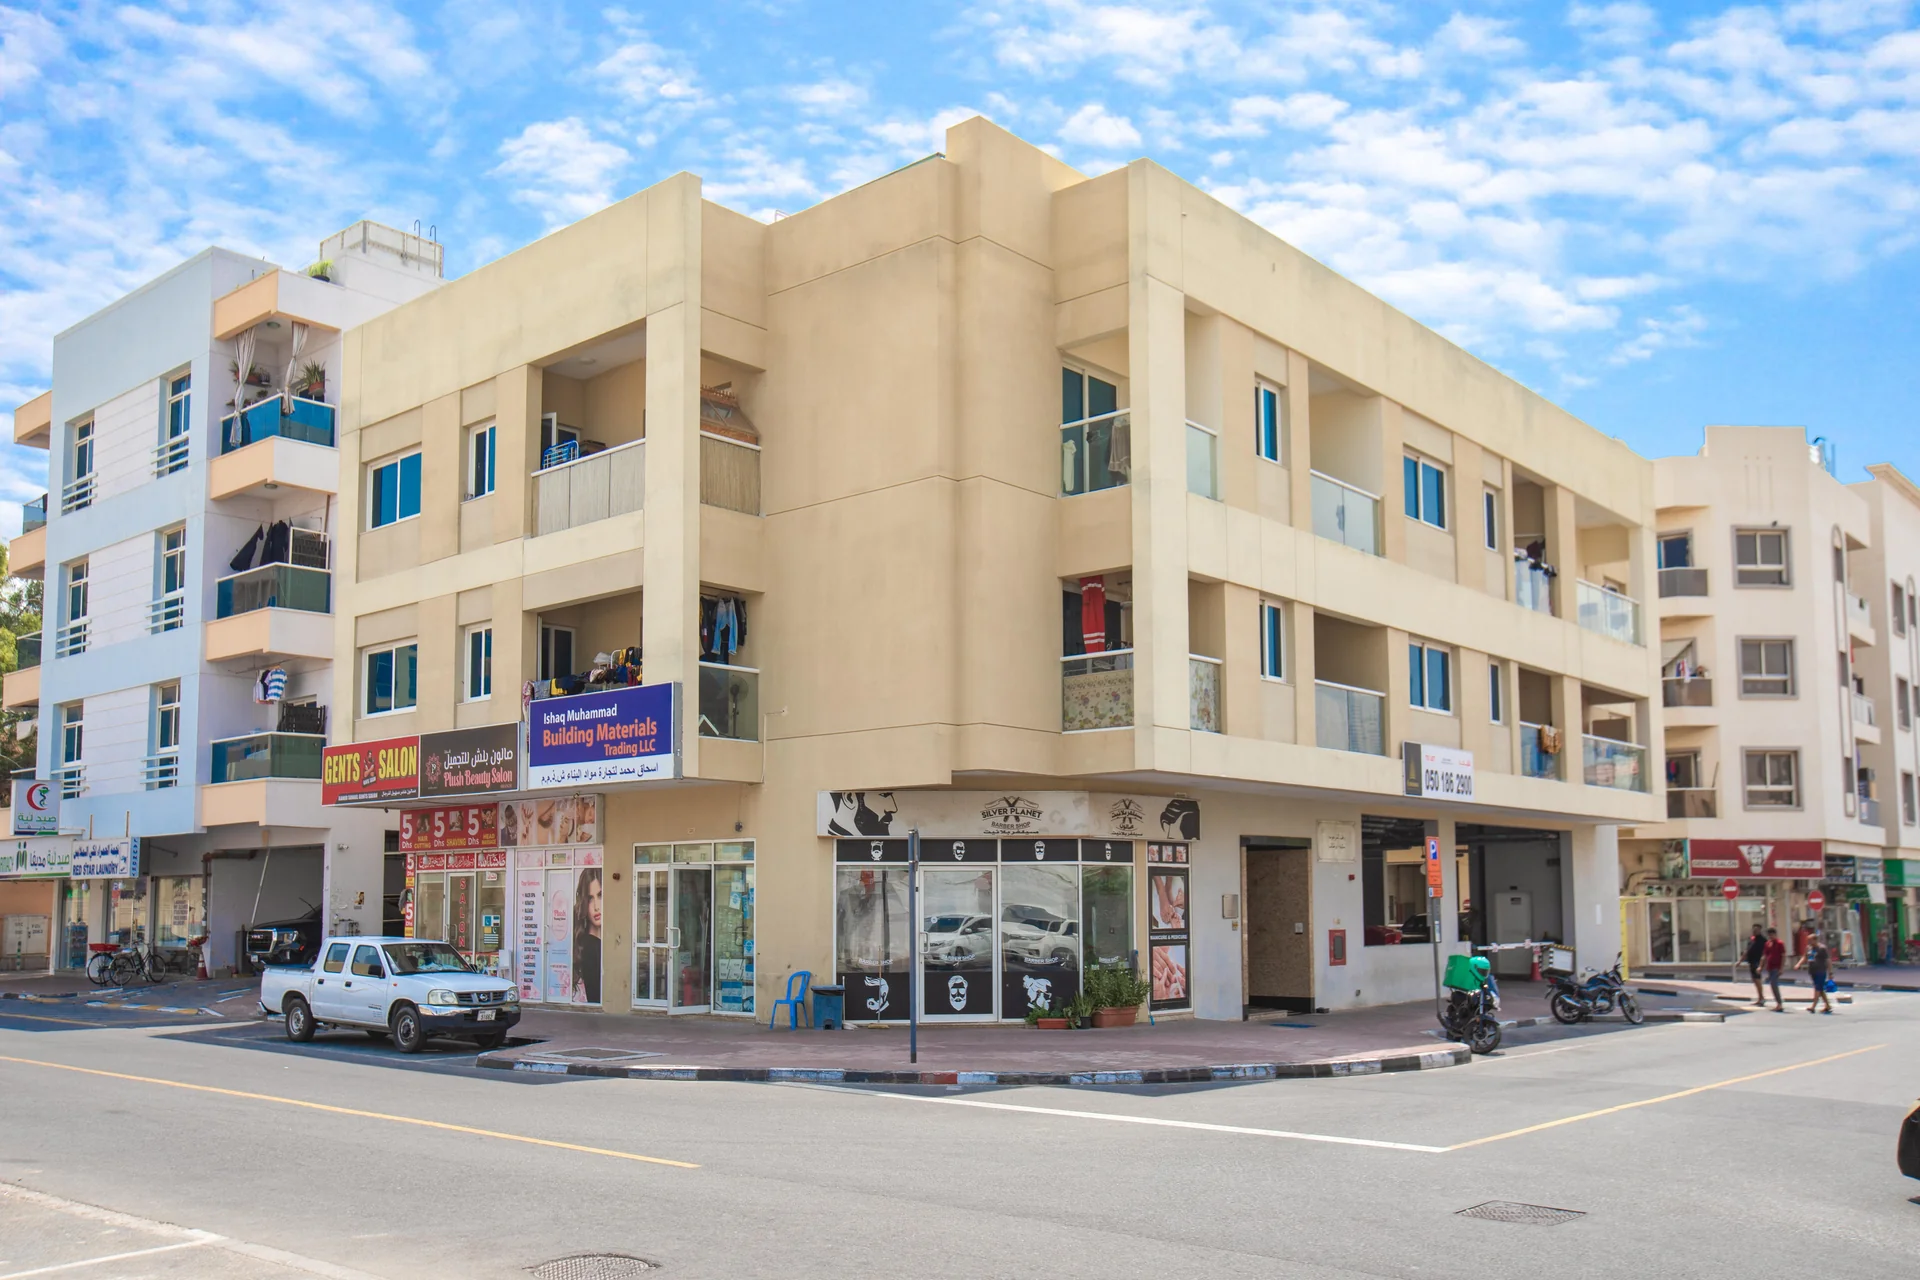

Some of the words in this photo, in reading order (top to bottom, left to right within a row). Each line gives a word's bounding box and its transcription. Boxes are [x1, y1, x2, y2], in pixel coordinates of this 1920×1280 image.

[543, 713, 566, 725] Ishaq
[566, 704, 618, 722] Muhammad
[543, 726, 594, 747] Building
[596, 717, 657, 741] Materials
[490, 747, 513, 766] صالون
[604, 743, 638, 757] Trading
[639, 739, 656, 752] LLC
[324, 752, 361, 785] GENTS
[378, 745, 417, 779] SALON
[443, 752, 470, 770] للتجميل
[470, 748, 489, 768] بلش
[443, 771, 464, 788] Plush
[464, 770, 491, 789] Beauty
[491, 766, 513, 784] Salon
[619, 767, 636, 775] محمد
[1425, 768, 1440, 791] 050
[1441, 771, 1454, 793] 186
[981, 808, 1008, 819] SILVER
[1010, 808, 1043, 818] PLANET
[402, 814, 413, 840] 5
[433, 812, 445, 838] 5
[467, 809, 479, 836] 5
[991, 821, 1014, 830] BARBER
[1015, 821, 1031, 830] SHOP
[402, 841, 413, 849] Dhs
[433, 840, 445, 848] Dhs
[467, 837, 480, 845] Dhs
[73, 864, 82, 876] RED
[83, 862, 96, 876] STAR
[96, 861, 119, 875] LAUNDRY
[407, 854, 415, 870] 5
[405, 903, 414, 920] 5
[459, 878, 467, 947] SALON
